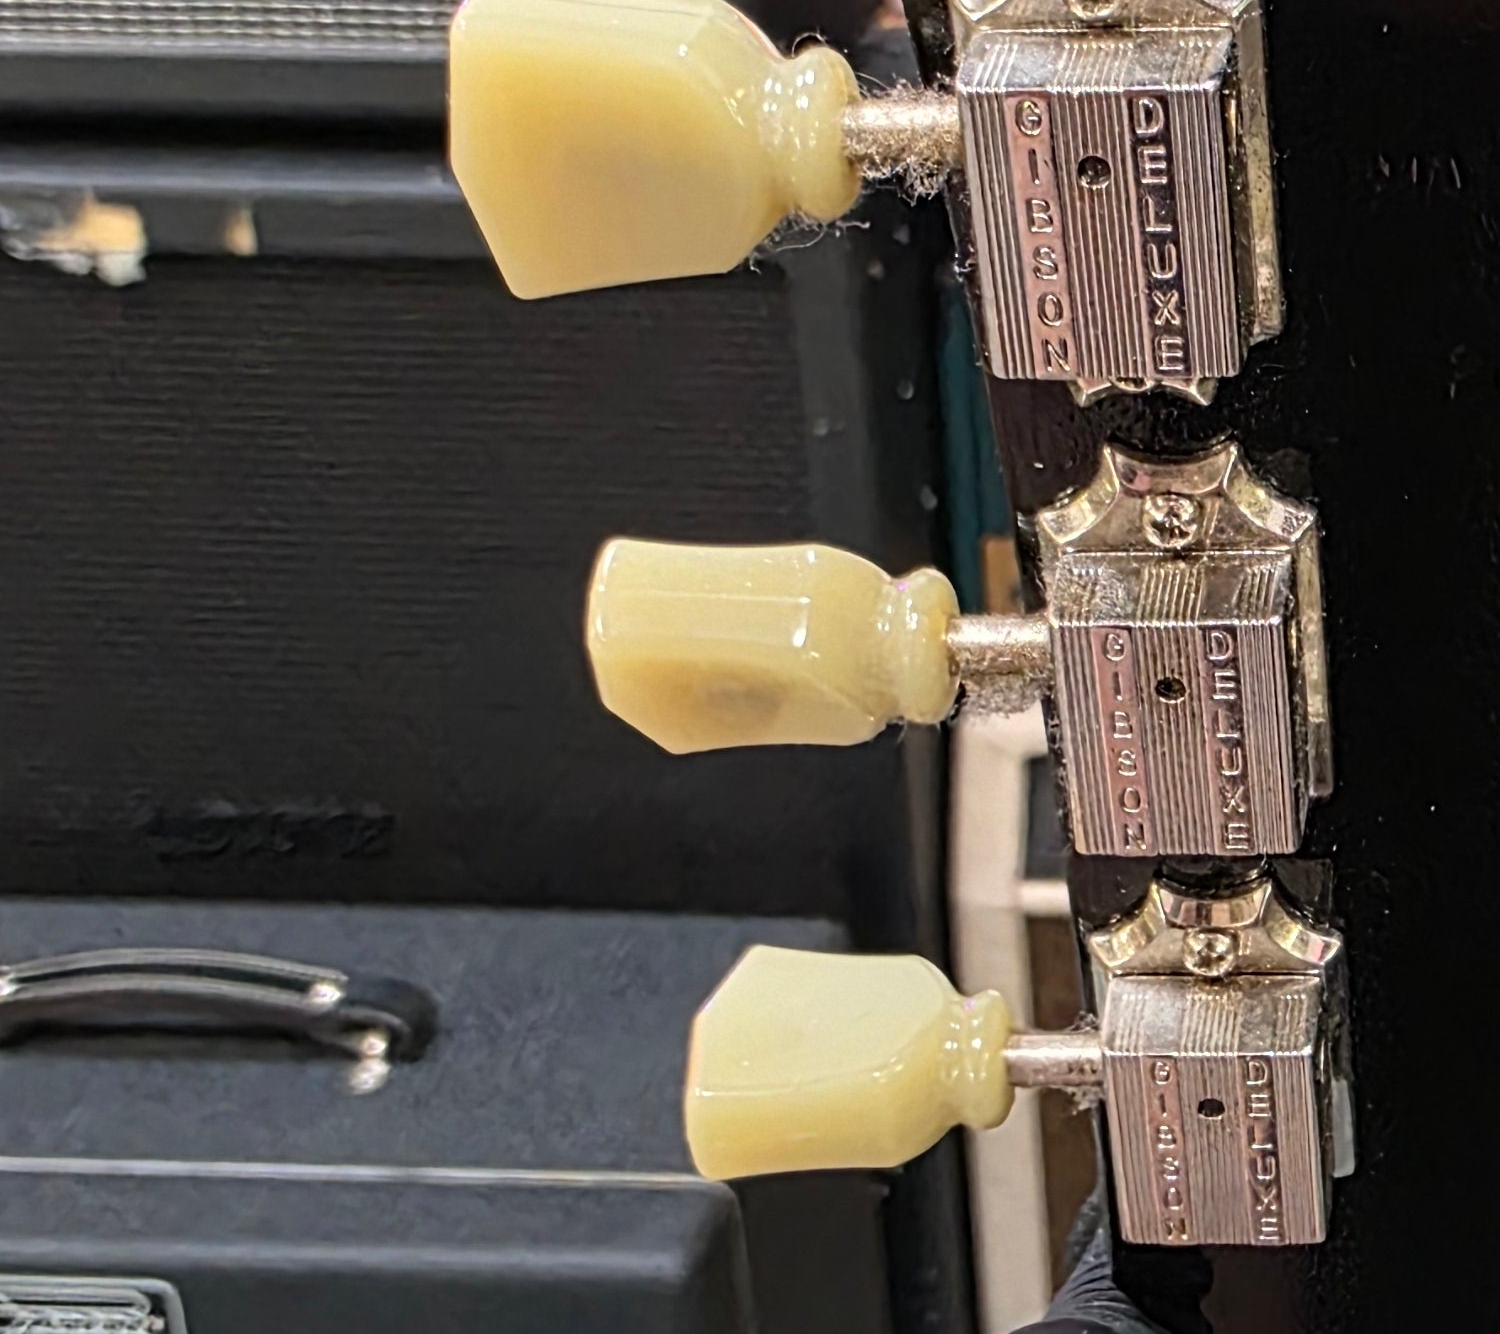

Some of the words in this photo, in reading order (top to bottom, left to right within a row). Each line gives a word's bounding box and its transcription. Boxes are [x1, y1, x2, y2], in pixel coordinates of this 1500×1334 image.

[1014, 98, 1071, 372] GIBSON
[1131, 97, 1185, 371] DELUXE
[1104, 633, 1147, 850] GIBSON
[1205, 631, 1249, 850] DELUXE
[1153, 1061, 1189, 1241] GIBSON
[1244, 1058, 1281, 1241] DELUXE
